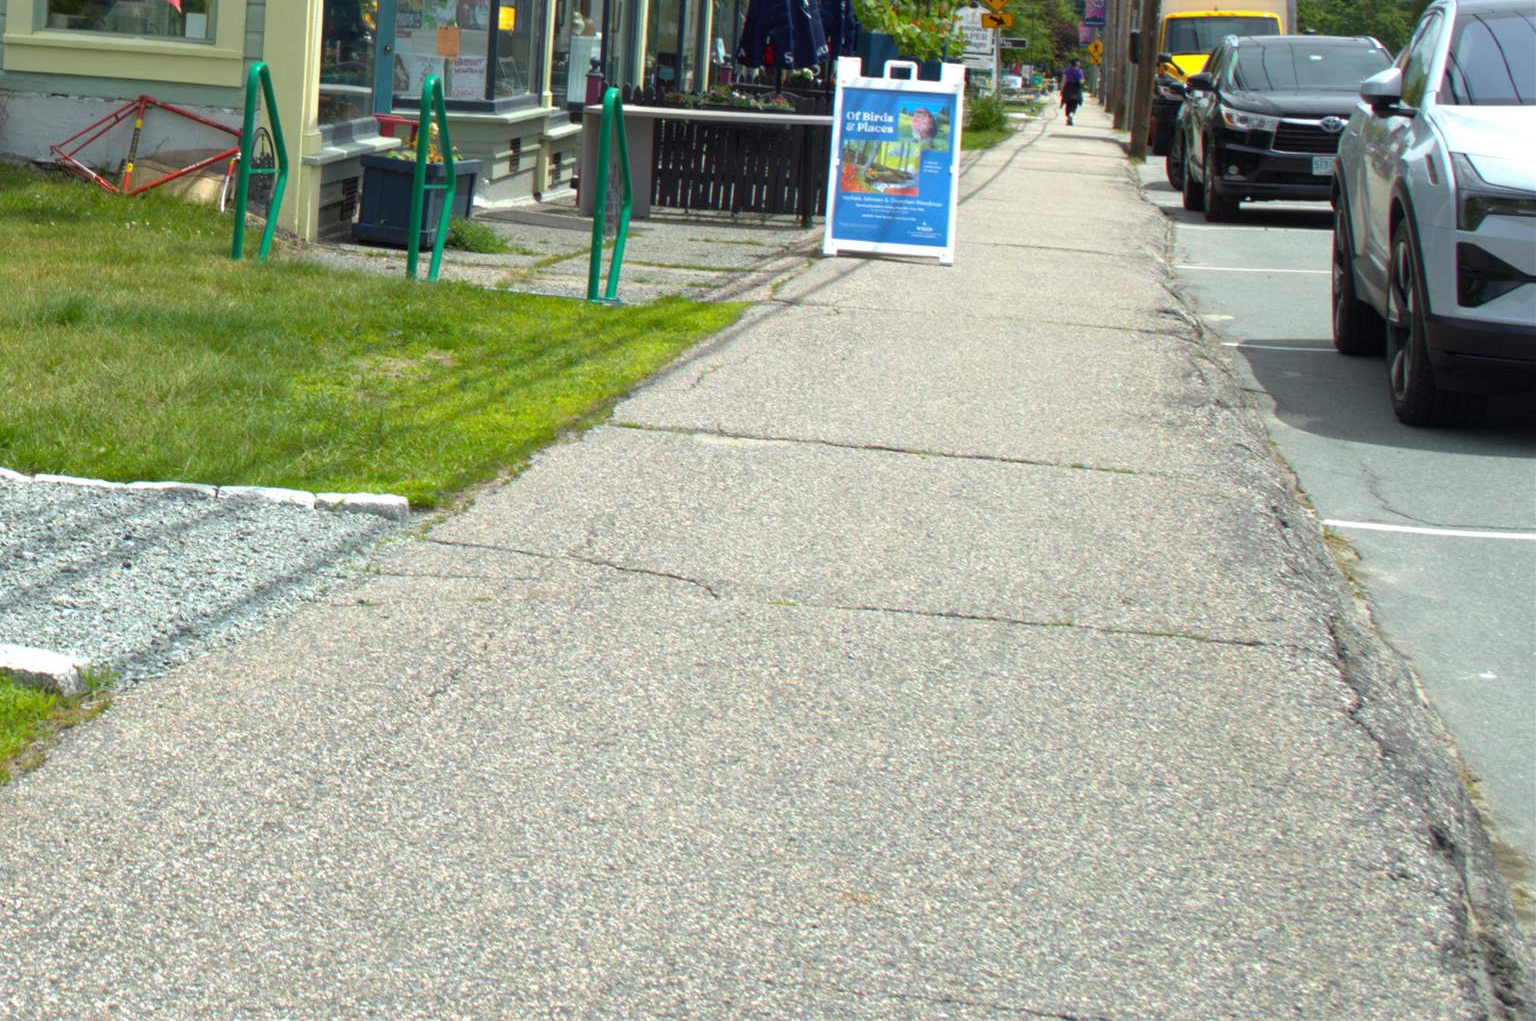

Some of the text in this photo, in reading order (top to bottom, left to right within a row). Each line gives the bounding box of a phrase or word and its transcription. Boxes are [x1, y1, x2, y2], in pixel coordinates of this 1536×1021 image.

[847, 111, 894, 123] Of Birds
[846, 122, 894, 134] & Places
